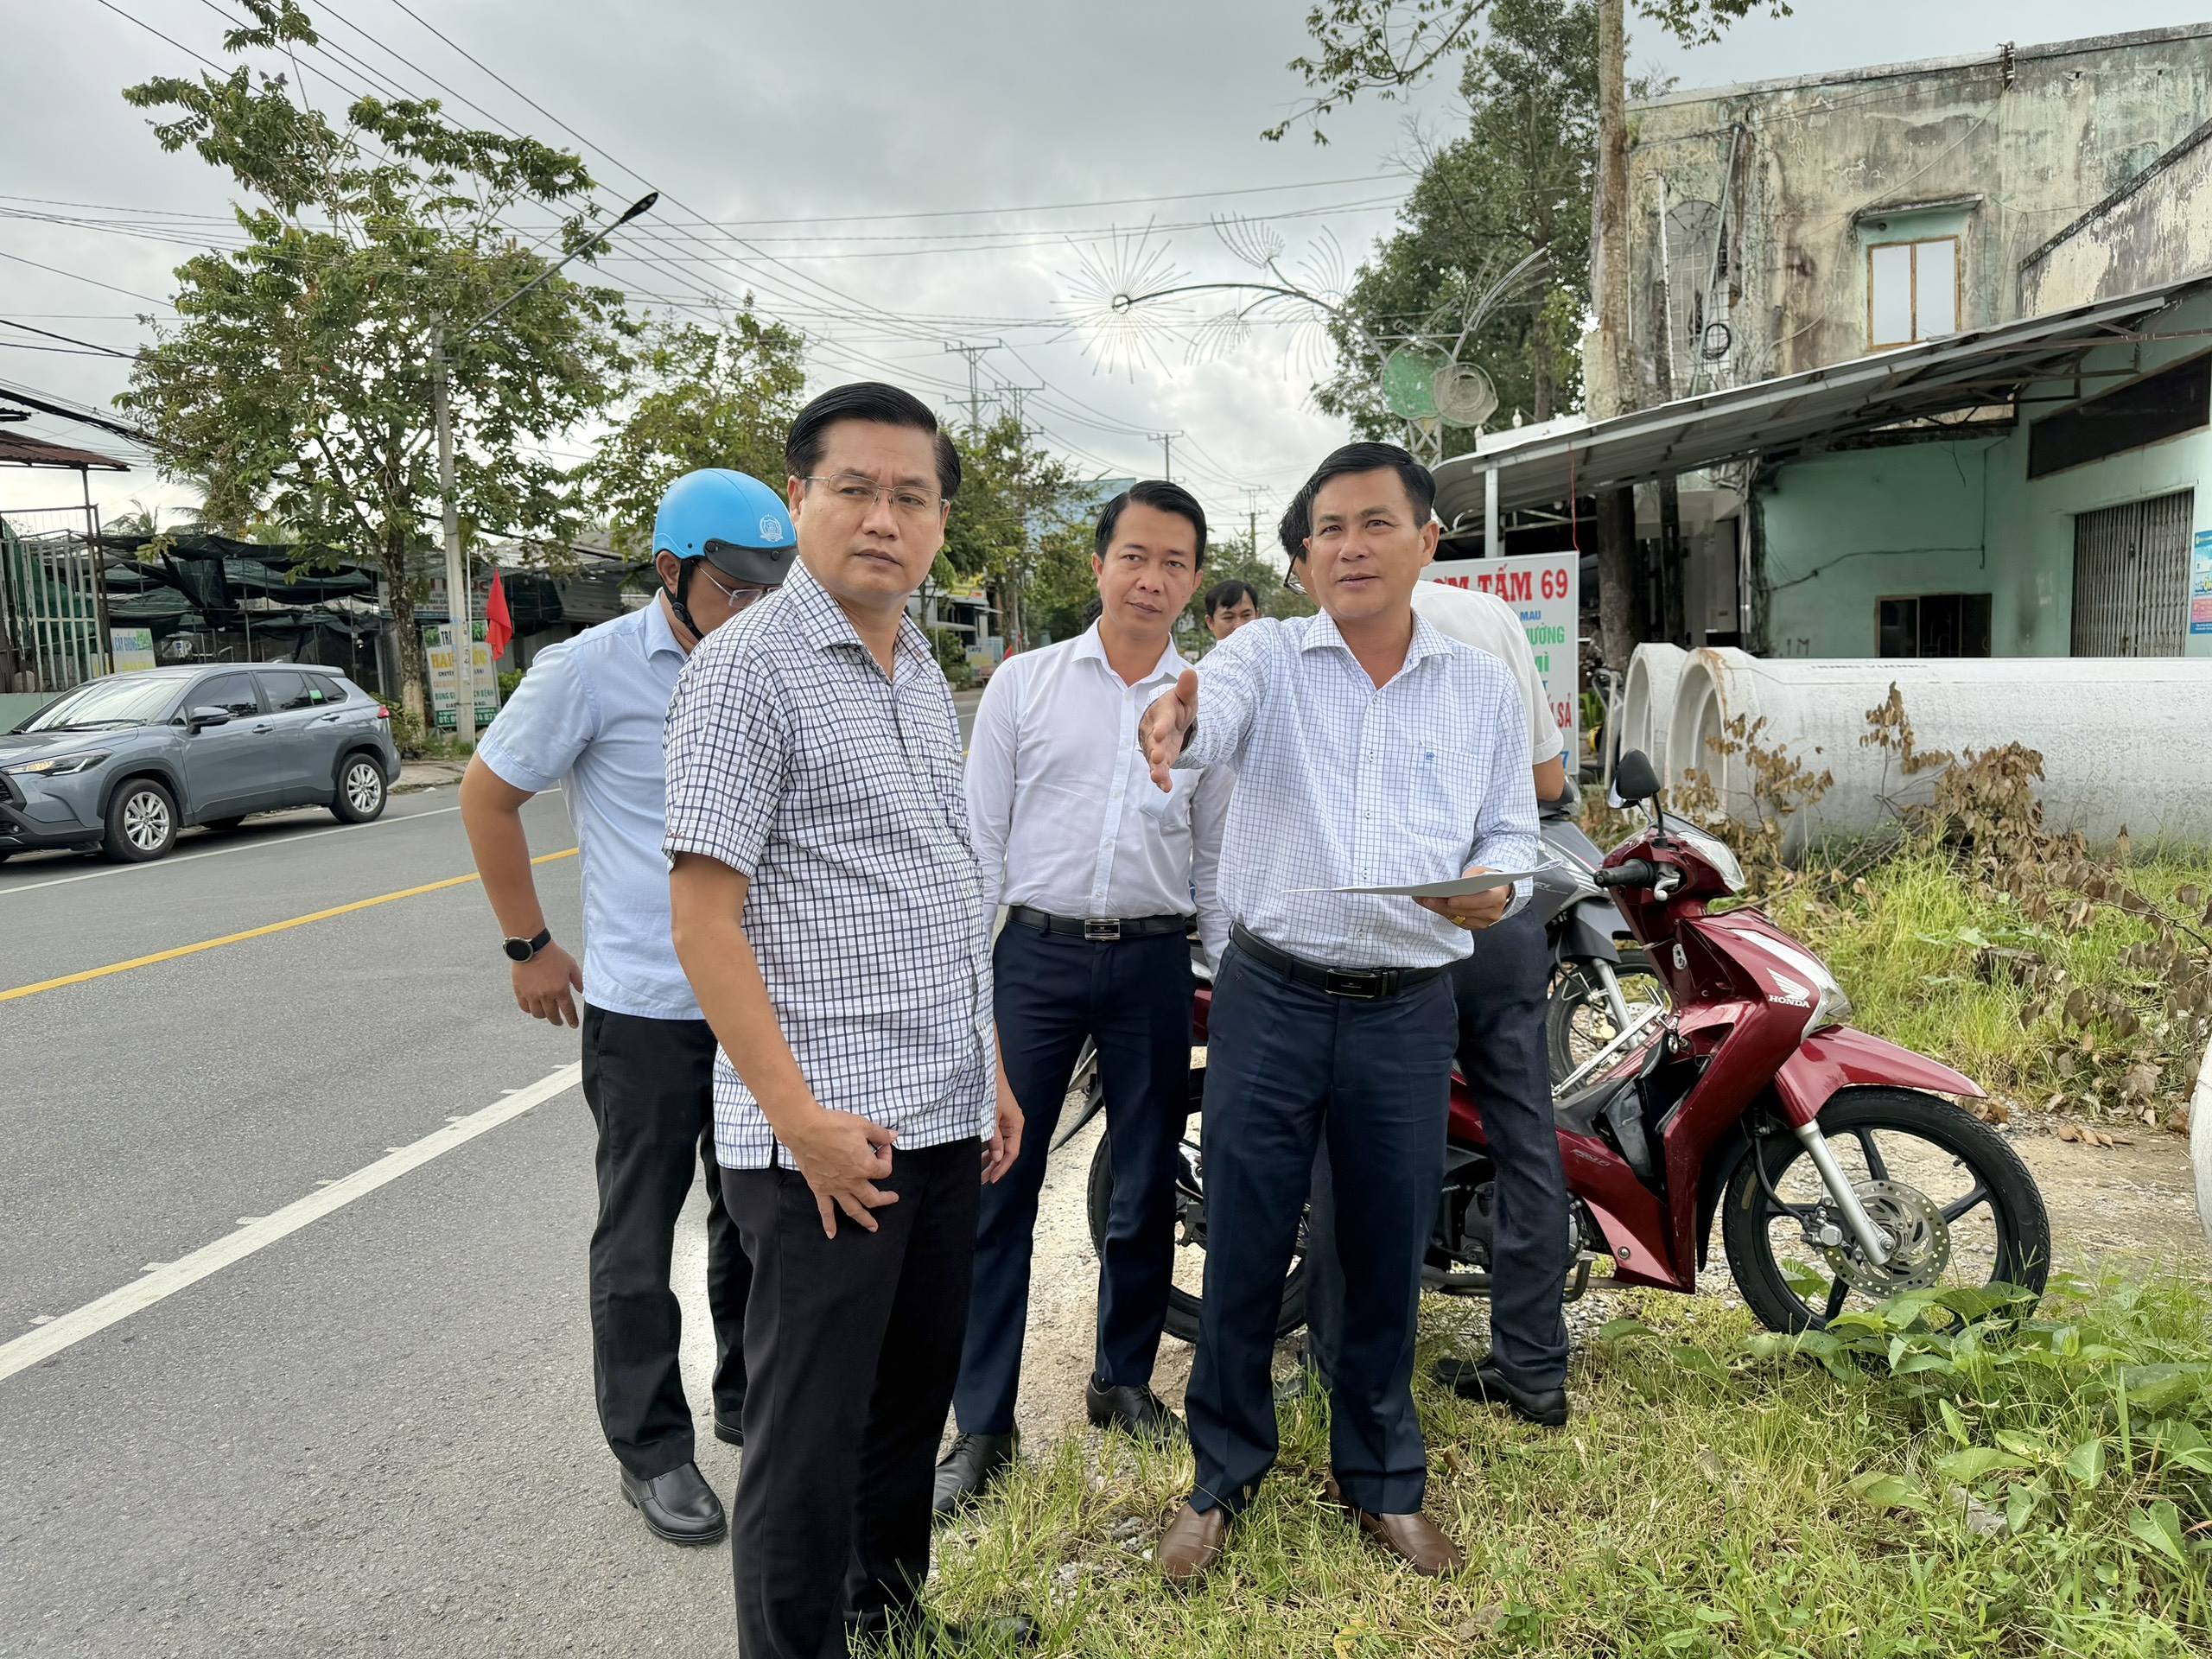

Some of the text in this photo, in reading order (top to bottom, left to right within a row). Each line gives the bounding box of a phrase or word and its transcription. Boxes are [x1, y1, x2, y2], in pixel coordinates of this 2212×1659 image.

[1478, 563, 1533, 602] TẤM
[1541, 569, 1569, 600] 69
[1557, 692, 1573, 728] SẢ
[1769, 995, 1811, 1008] HONDA
